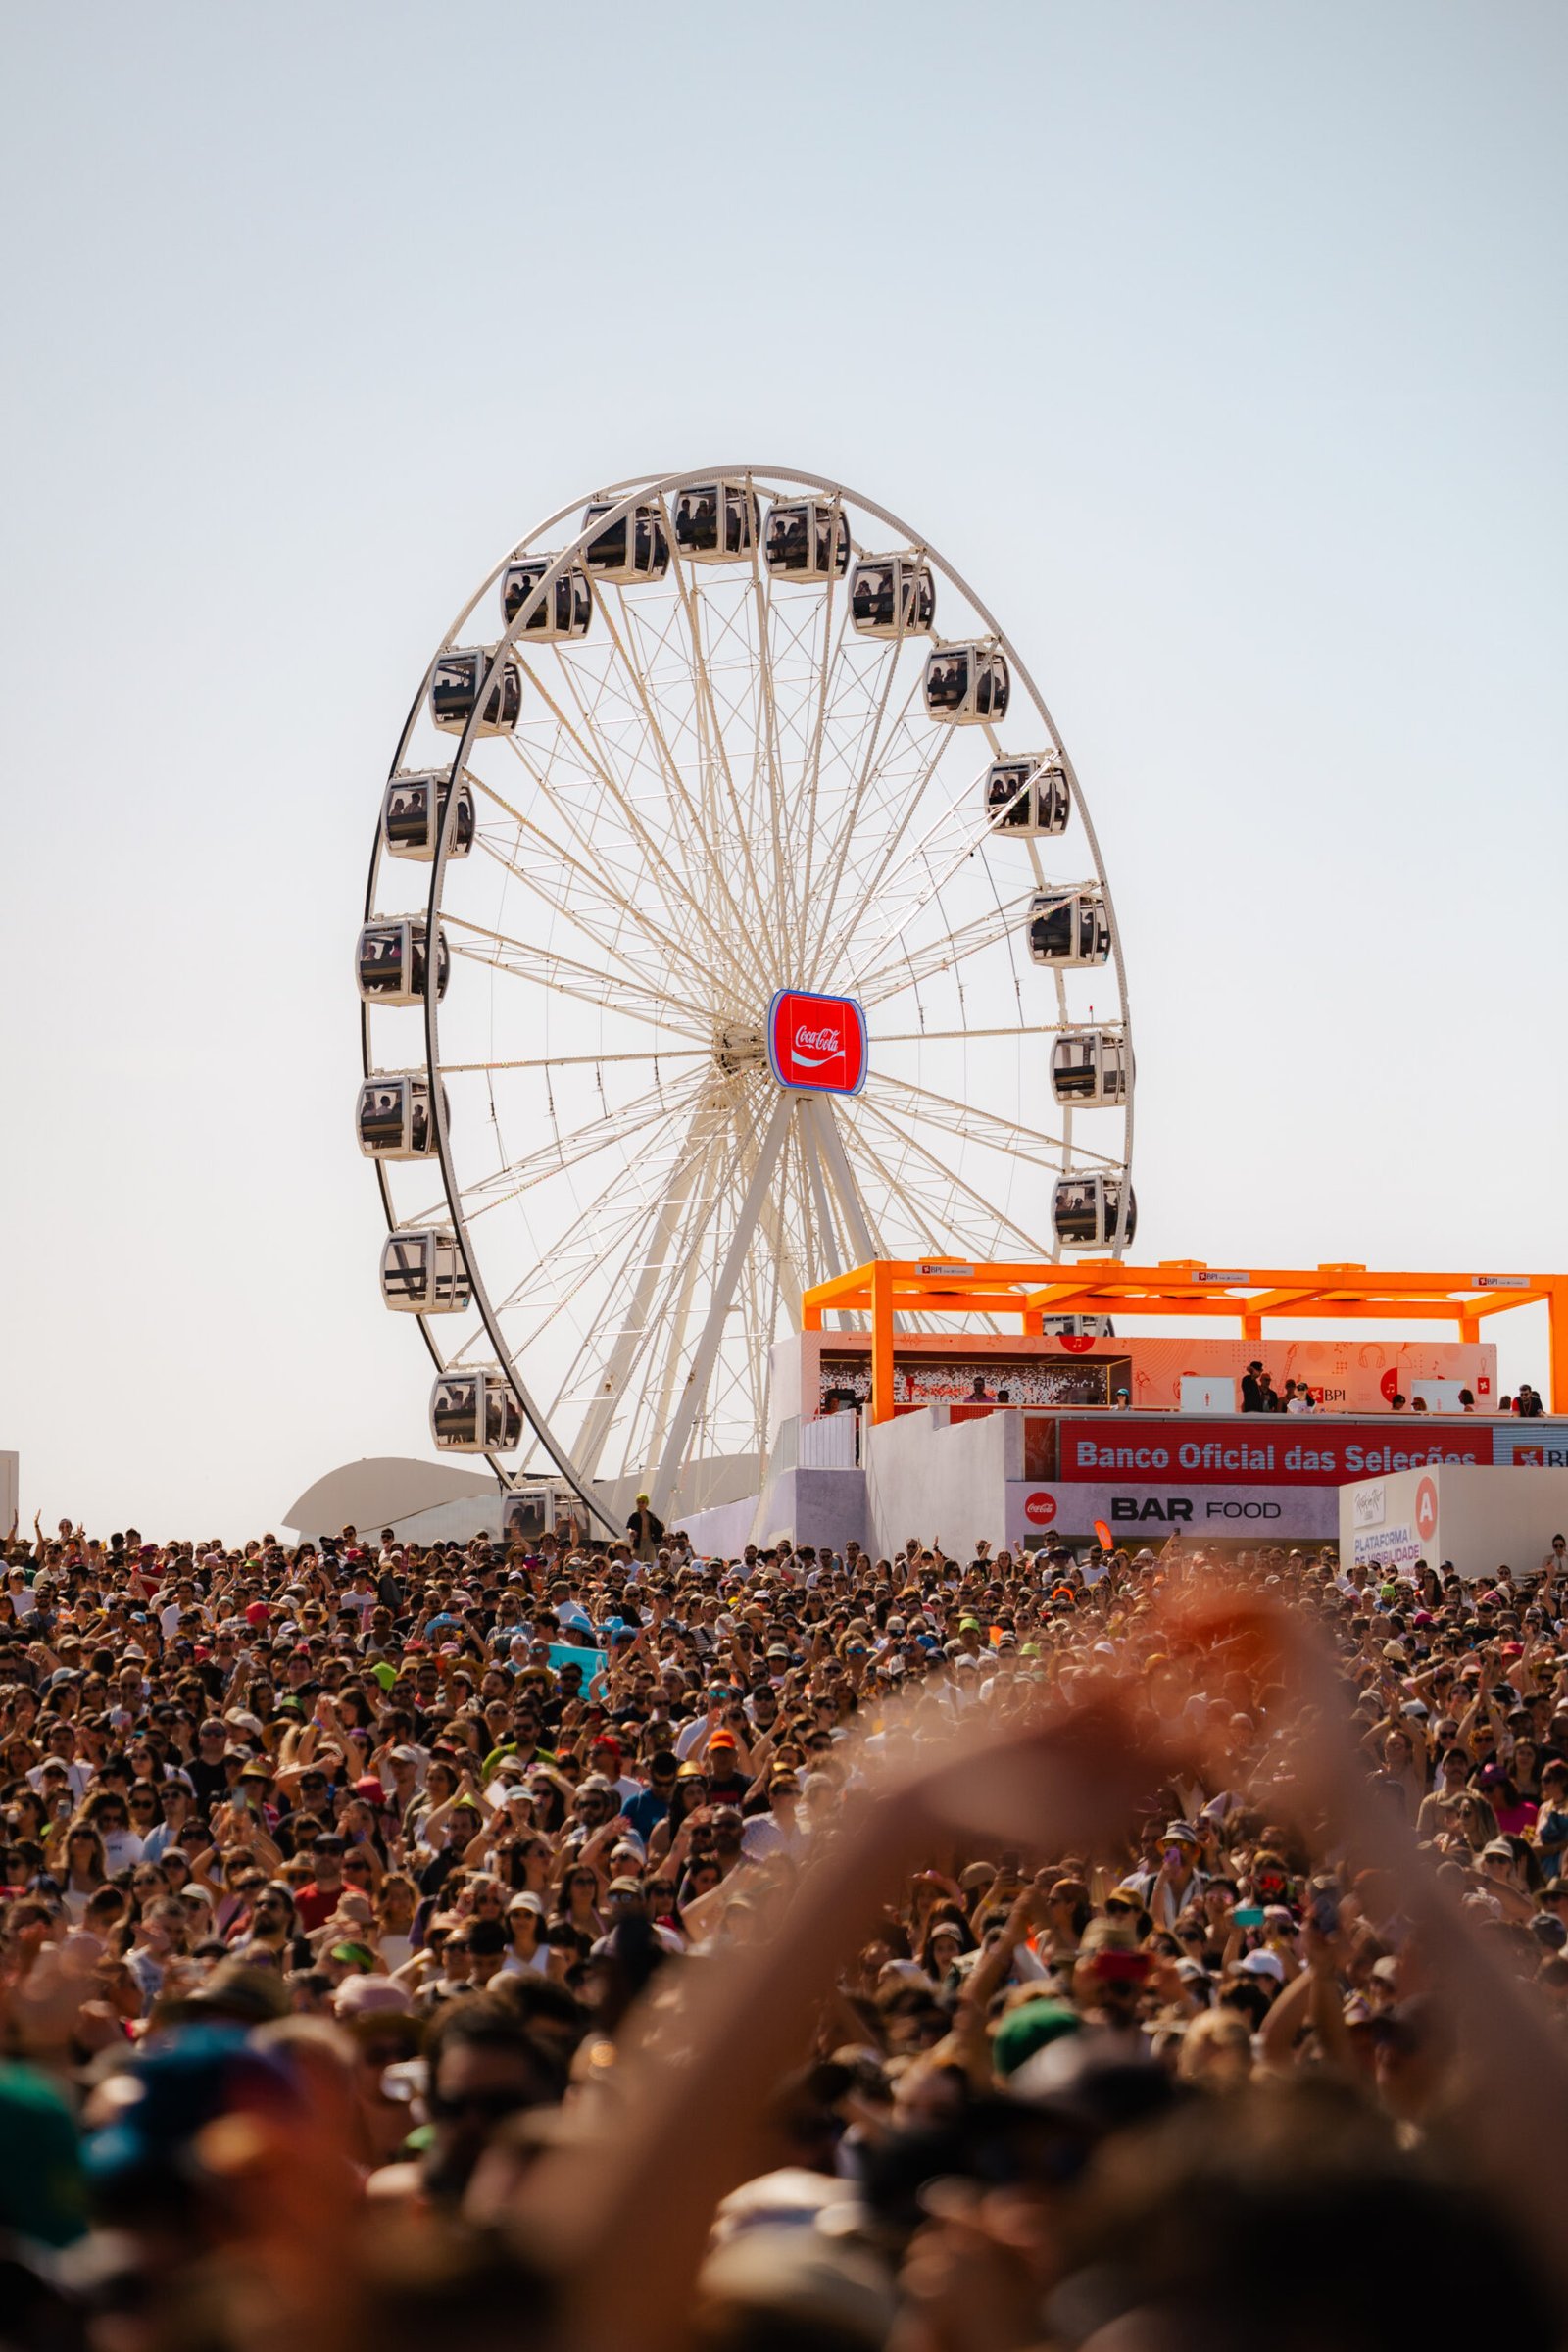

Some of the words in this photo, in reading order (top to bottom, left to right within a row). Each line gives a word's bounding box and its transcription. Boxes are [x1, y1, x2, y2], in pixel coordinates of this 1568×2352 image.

[795, 1025, 841, 1052] Coca-Cola
[1324, 1389, 1346, 1401] BPI
[1077, 1441, 1169, 1469] Banco
[1178, 1443, 1275, 1470] Oficial
[1284, 1445, 1336, 1472] das
[1027, 1503, 1054, 1513] Coca-Cola
[1111, 1497, 1194, 1521] BAR
[1206, 1502, 1281, 1519] FOOD
[1419, 1492, 1433, 1523] A
[1354, 1528, 1408, 1552] PLATAFORMA
